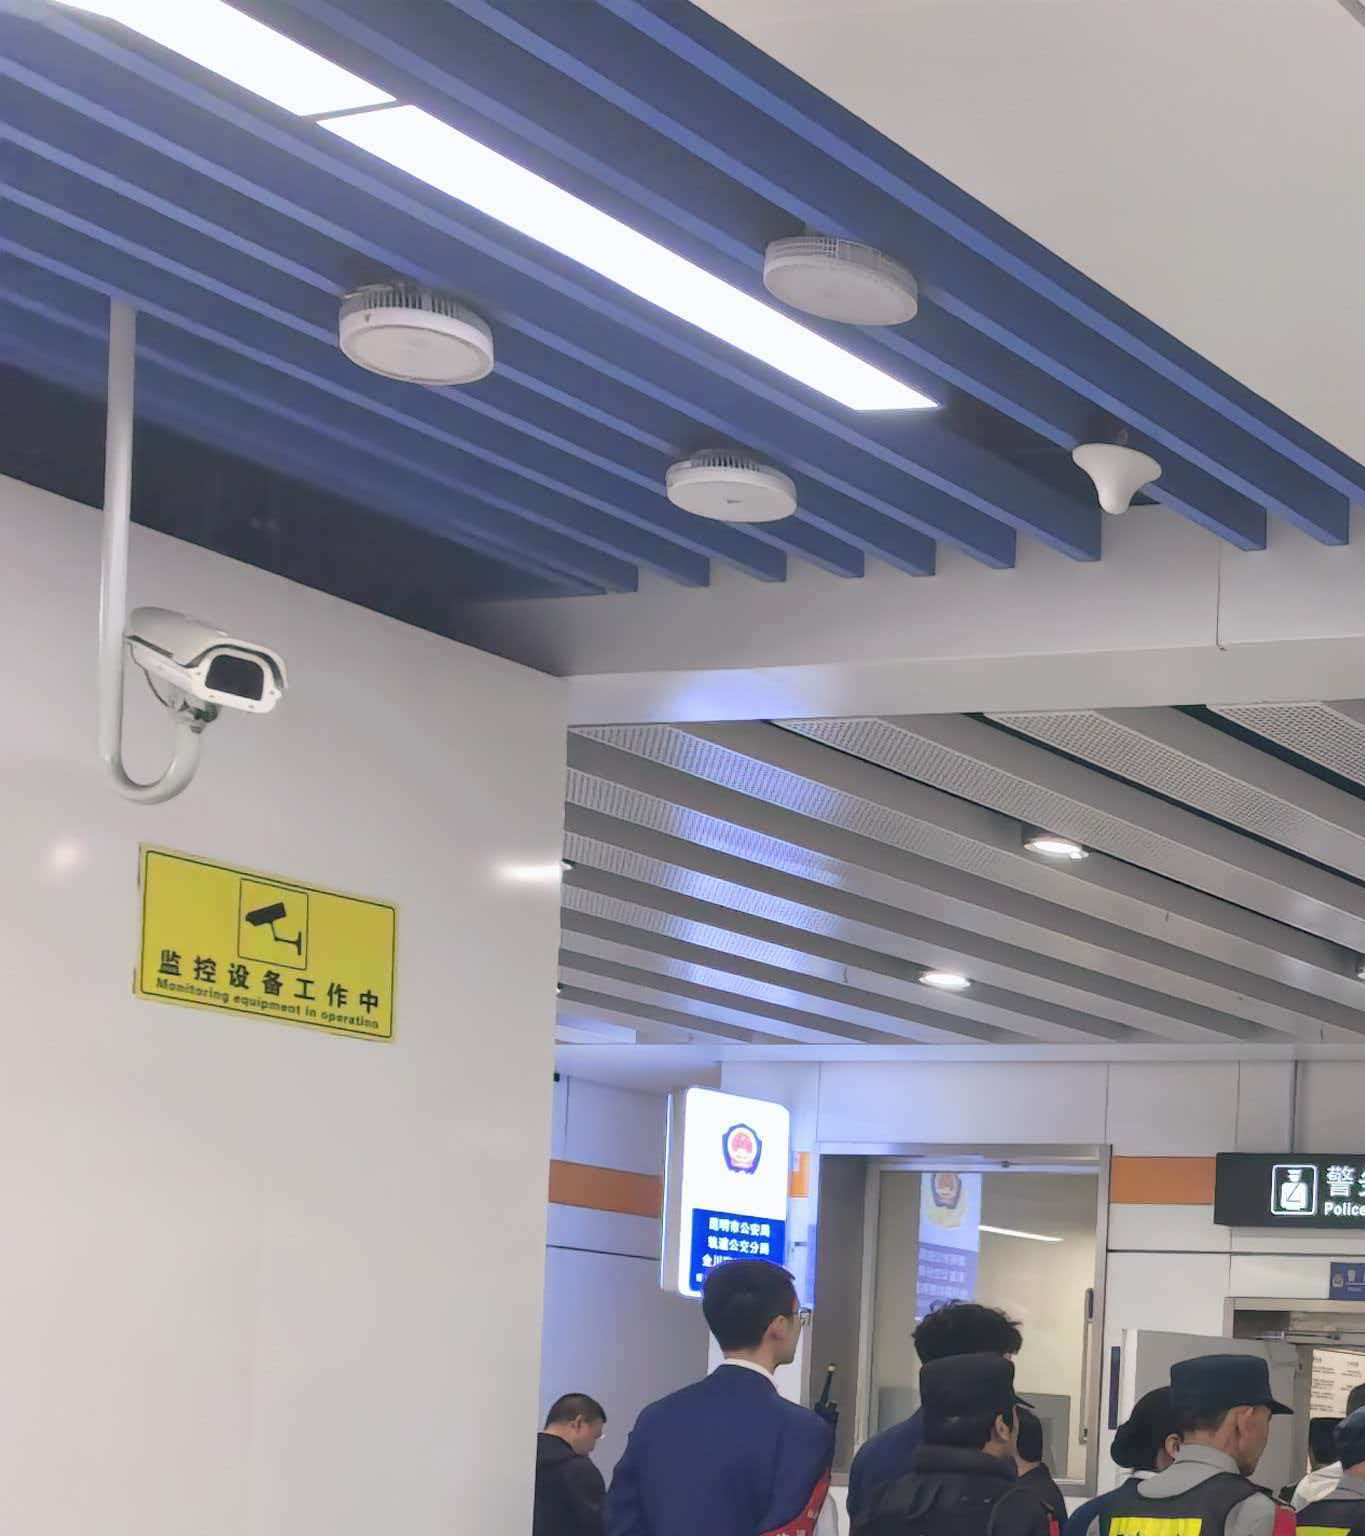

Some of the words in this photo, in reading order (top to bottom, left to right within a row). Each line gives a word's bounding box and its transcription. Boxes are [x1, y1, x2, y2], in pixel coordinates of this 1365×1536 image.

[156, 977, 230, 1003] Monitoring
[233, 994, 301, 1015] equipment
[305, 1004, 317, 1019] in
[321, 1009, 379, 1029] operation
[158, 949, 379, 1014] 监控设备工作中
[708, 1217, 771, 1238] 昆明市公安局
